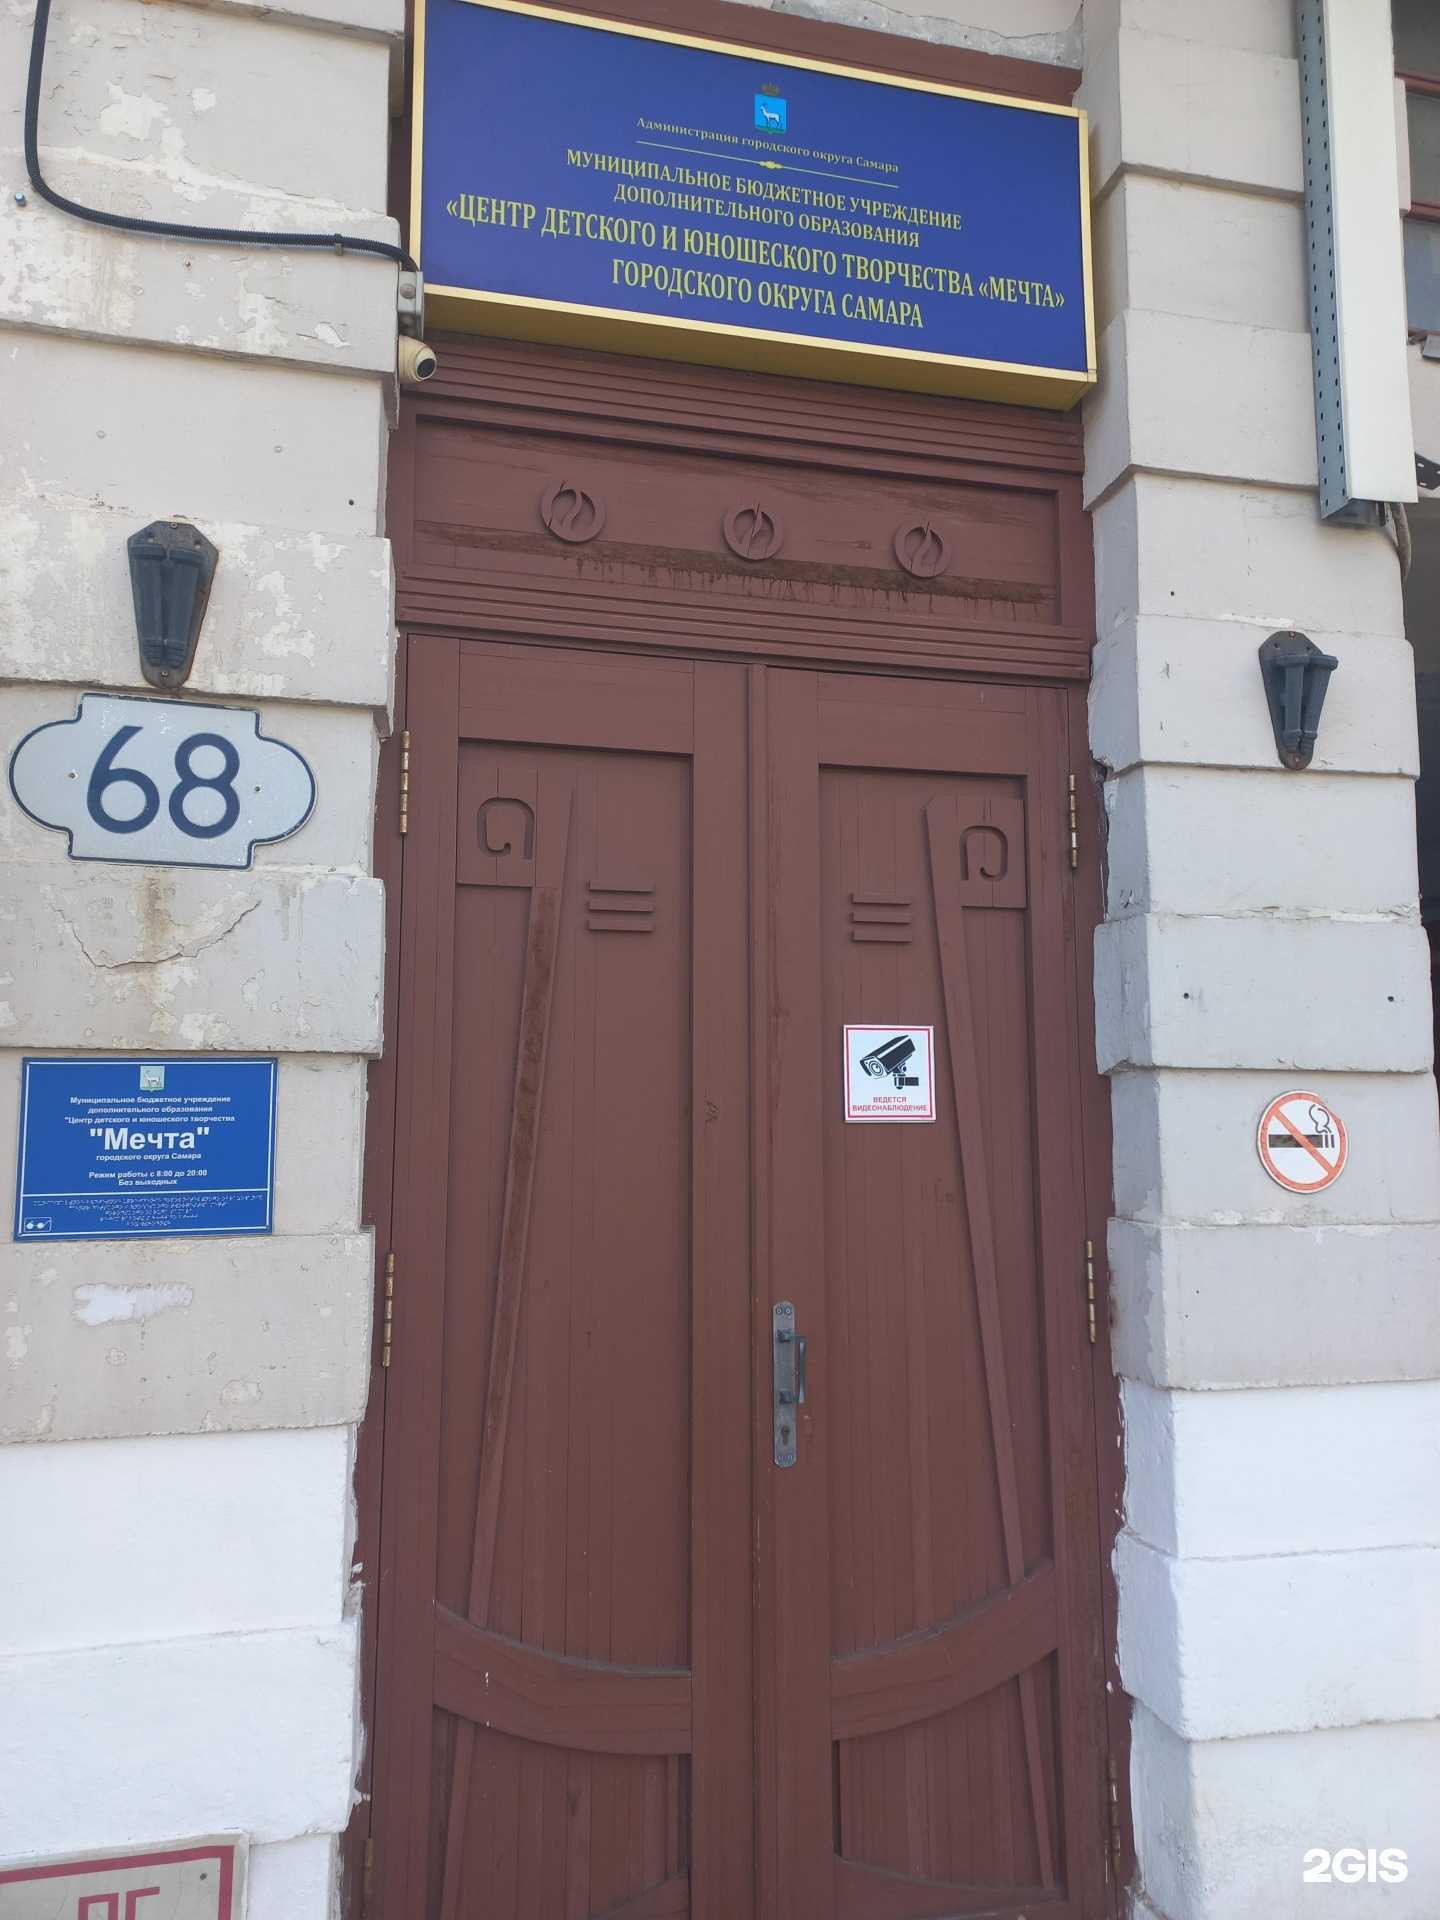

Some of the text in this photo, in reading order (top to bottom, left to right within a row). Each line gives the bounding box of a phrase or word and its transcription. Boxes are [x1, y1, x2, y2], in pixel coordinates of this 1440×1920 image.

[636, 117, 899, 174] Администрация городского округа Самара
[566, 149, 962, 231] МУНИЦИПАЛЬНОЕ БЮДЖЕТНОЕ УЧРЕЖДЕНИЕ
[614, 183, 920, 248] ДОПОЛНИТЕЛЬНОГО ОБРАЗОВАНИЯ
[446, 193, 1065, 310] «ЦЕНТР ДЕТСКОГО И ЮНОШЕСКОГО ТВОРЧЕСТВА «МЕЧТА»
[612, 258, 924, 329] ГОРОДСКОГО ОКРУГА САМАРА
[86, 725, 241, 840] 68
[70, 1096, 135, 1105] Муниципальное
[184, 1095, 231, 1104] учреждение
[88, 1105, 213, 1114] дополнительного образования
[64, 1116, 93, 1124] "Центр
[94, 1115, 130, 1123] детского
[89, 1126, 210, 1150] "Мечта"
[96, 1152, 201, 1162] городского округа Самара
[88, 1171, 116, 1179] Режим
[117, 1170, 148, 1178] работы
[135, 1178, 178, 1186] выходных
